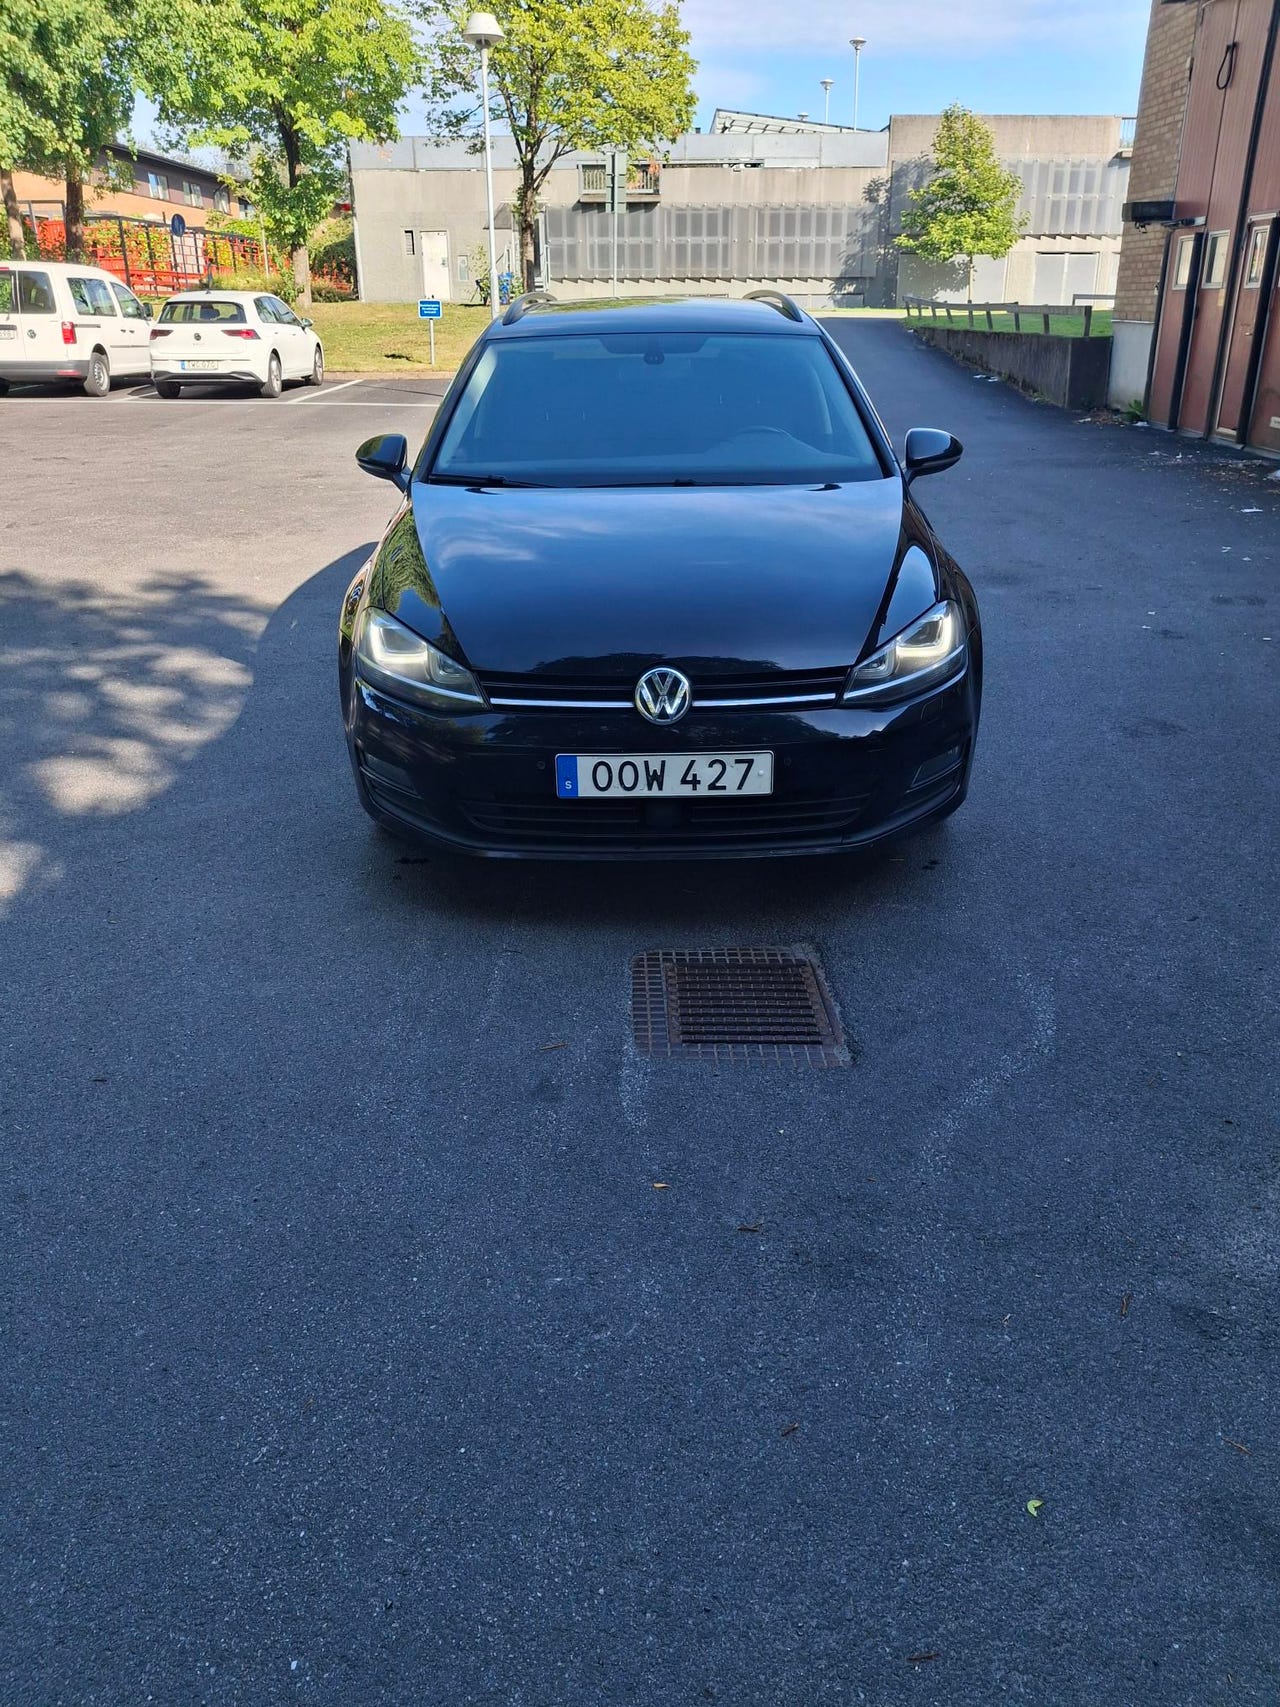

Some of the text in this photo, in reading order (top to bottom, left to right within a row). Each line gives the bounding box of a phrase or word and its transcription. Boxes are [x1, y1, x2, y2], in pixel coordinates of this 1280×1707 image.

[565, 780, 572, 790] S
[592, 758, 755, 792] OOW 427
